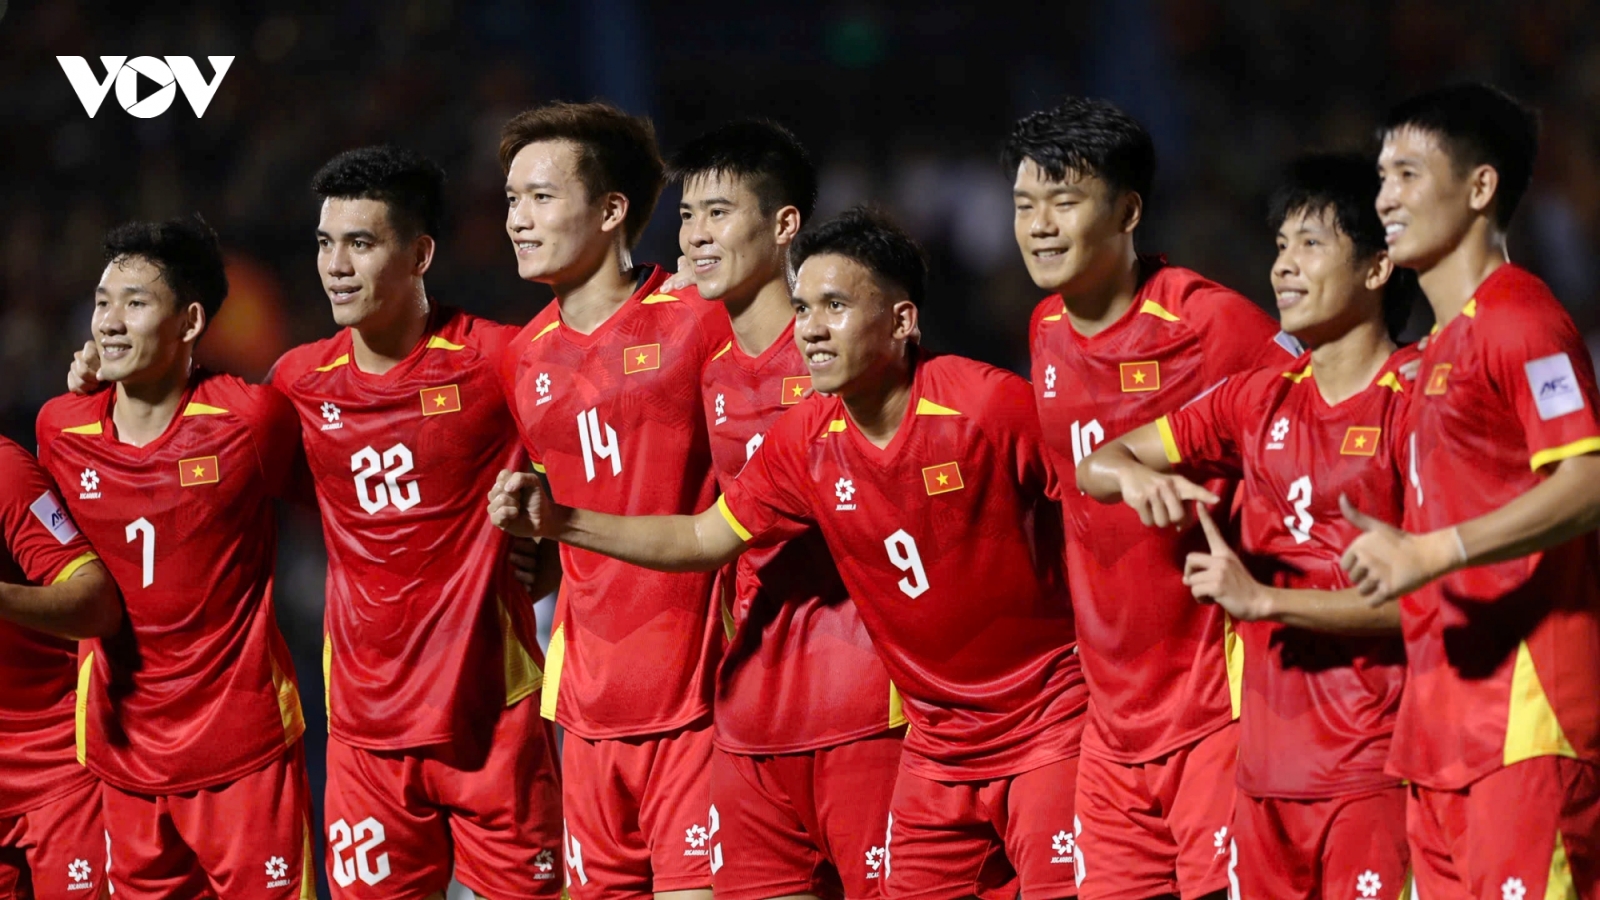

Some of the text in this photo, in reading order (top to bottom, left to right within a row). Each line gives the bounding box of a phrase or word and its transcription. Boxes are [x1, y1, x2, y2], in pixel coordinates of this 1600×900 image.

[351, 442, 421, 515] 22
[576, 406, 622, 483] 14
[1284, 475, 1314, 544] 3
[125, 517, 156, 588] 7
[884, 528, 930, 599] 9
[329, 816, 391, 888] 22
